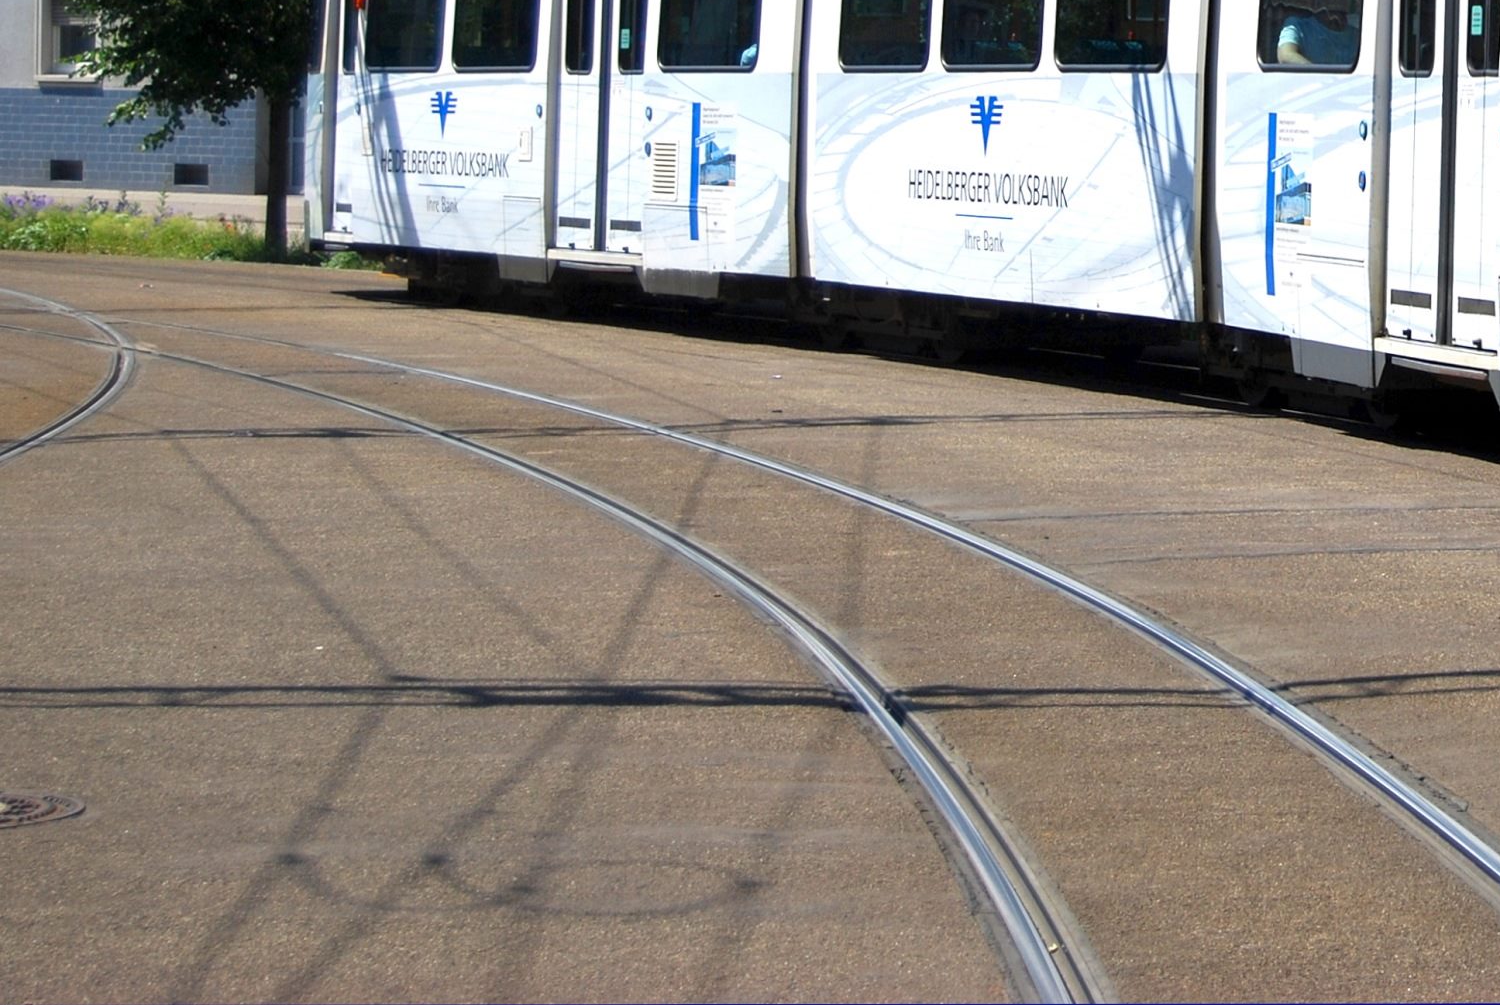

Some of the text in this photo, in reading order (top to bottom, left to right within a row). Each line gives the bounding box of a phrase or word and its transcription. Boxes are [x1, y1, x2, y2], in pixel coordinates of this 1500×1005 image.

[381, 149, 510, 178] HEIDELBERGER VOLKSBANK
[908, 169, 1069, 208] HEIDELBERGER VOLKSBANK
[440, 196, 459, 214] Bank
[964, 228, 1005, 253] Ihre Bank
